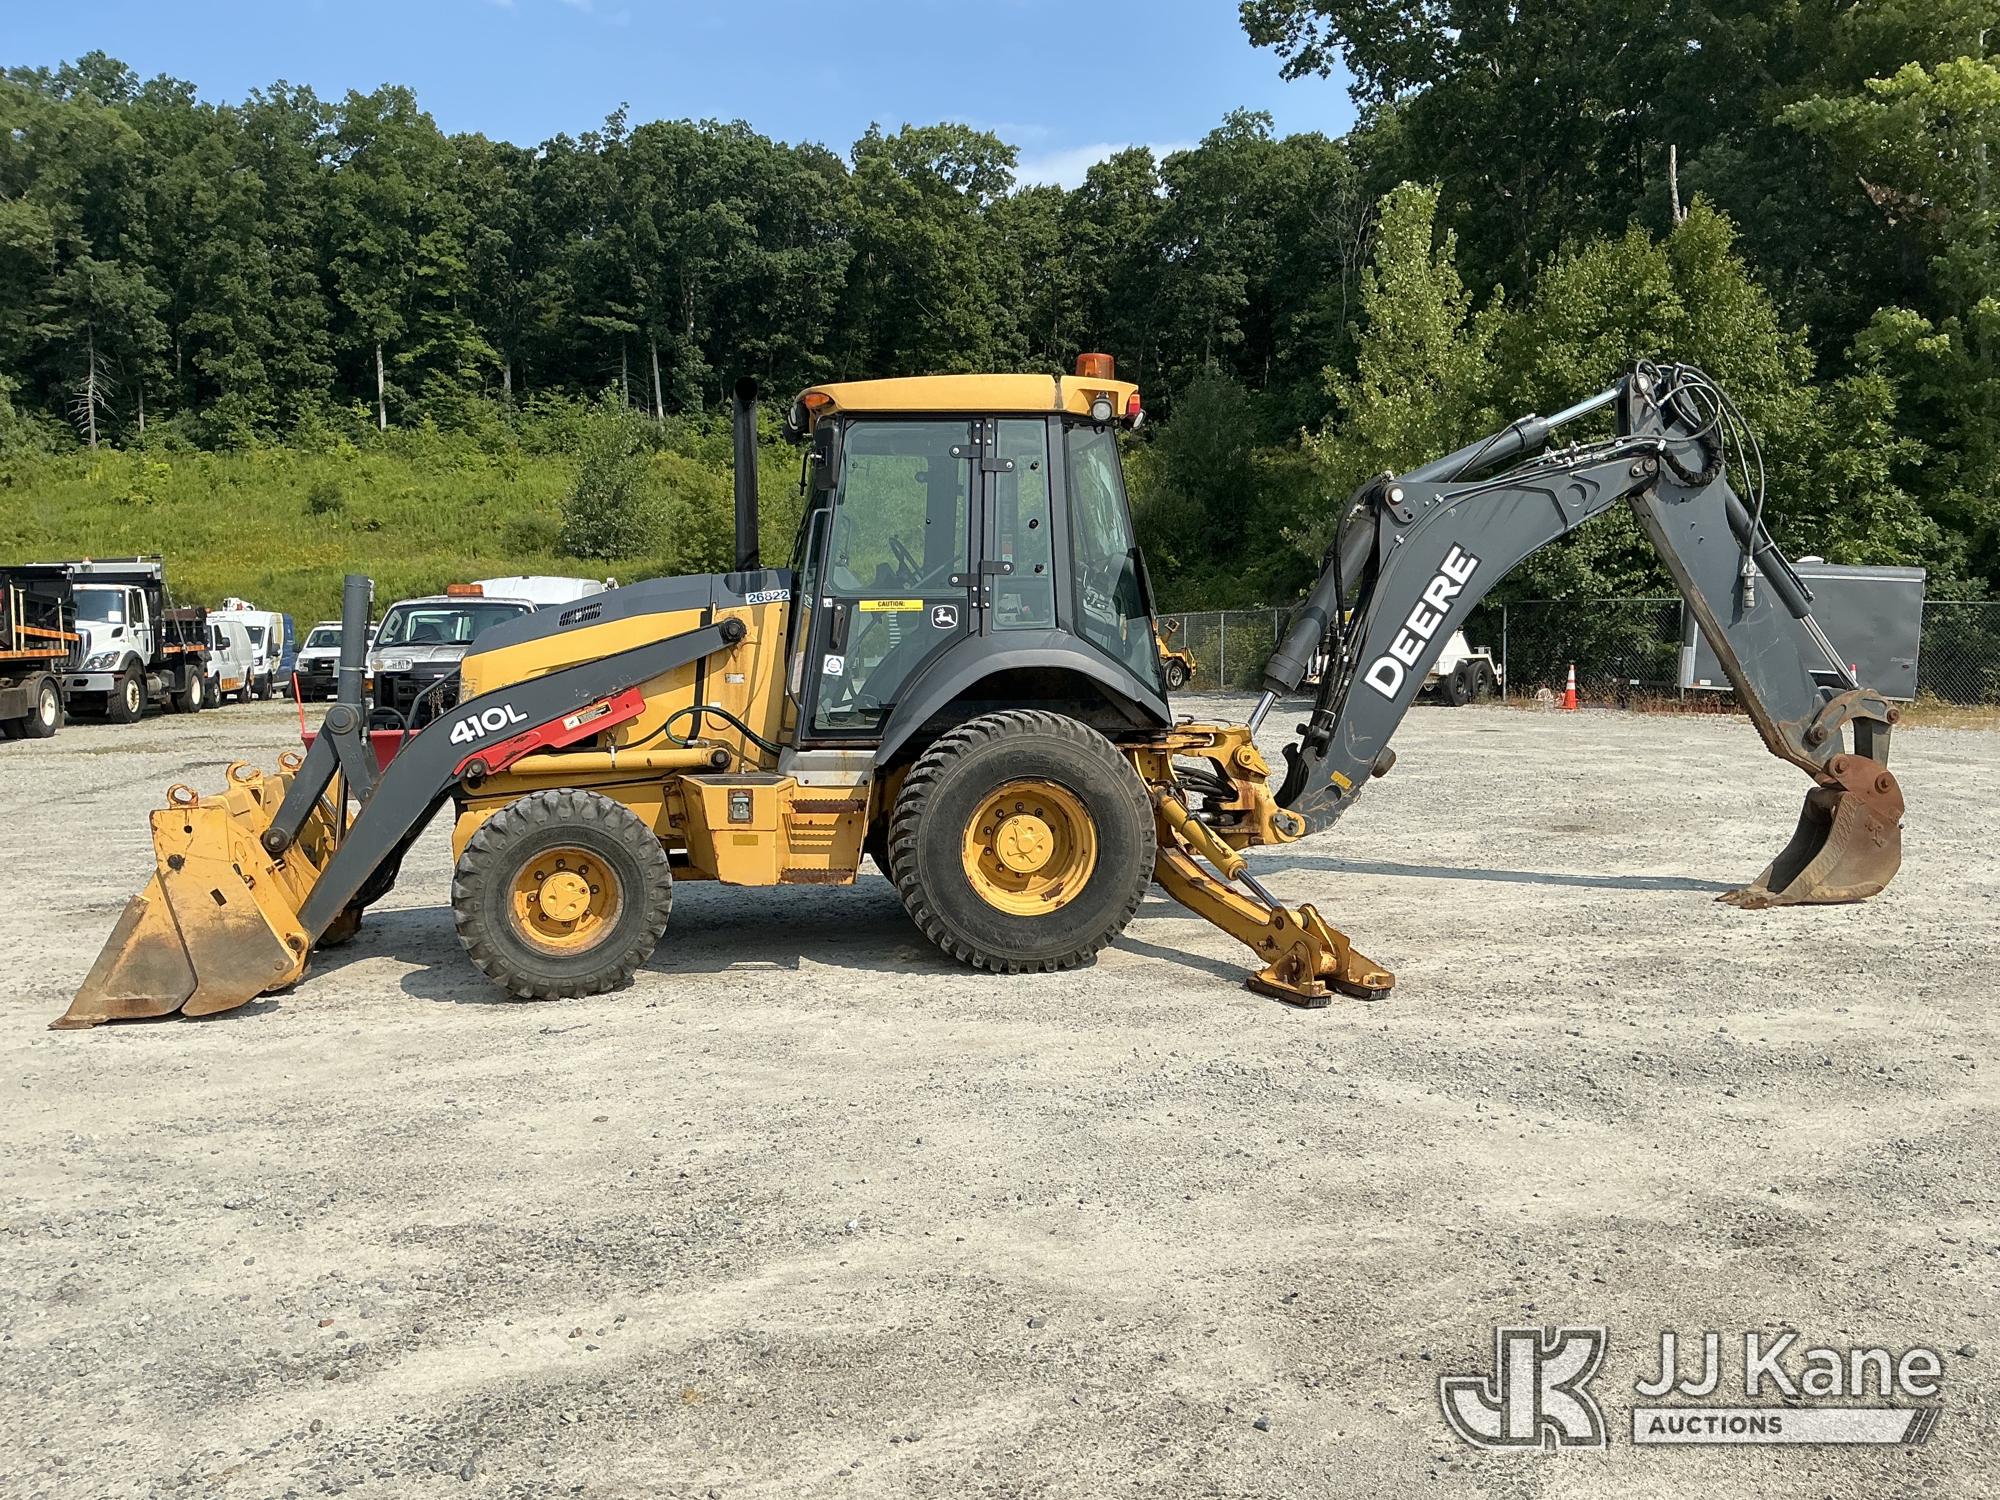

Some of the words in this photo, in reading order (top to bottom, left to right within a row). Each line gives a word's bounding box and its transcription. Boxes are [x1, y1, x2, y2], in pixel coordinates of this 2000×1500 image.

[748, 591, 789, 603] 26822
[1363, 544, 1479, 700] DEERE
[449, 703, 529, 744] 410L
